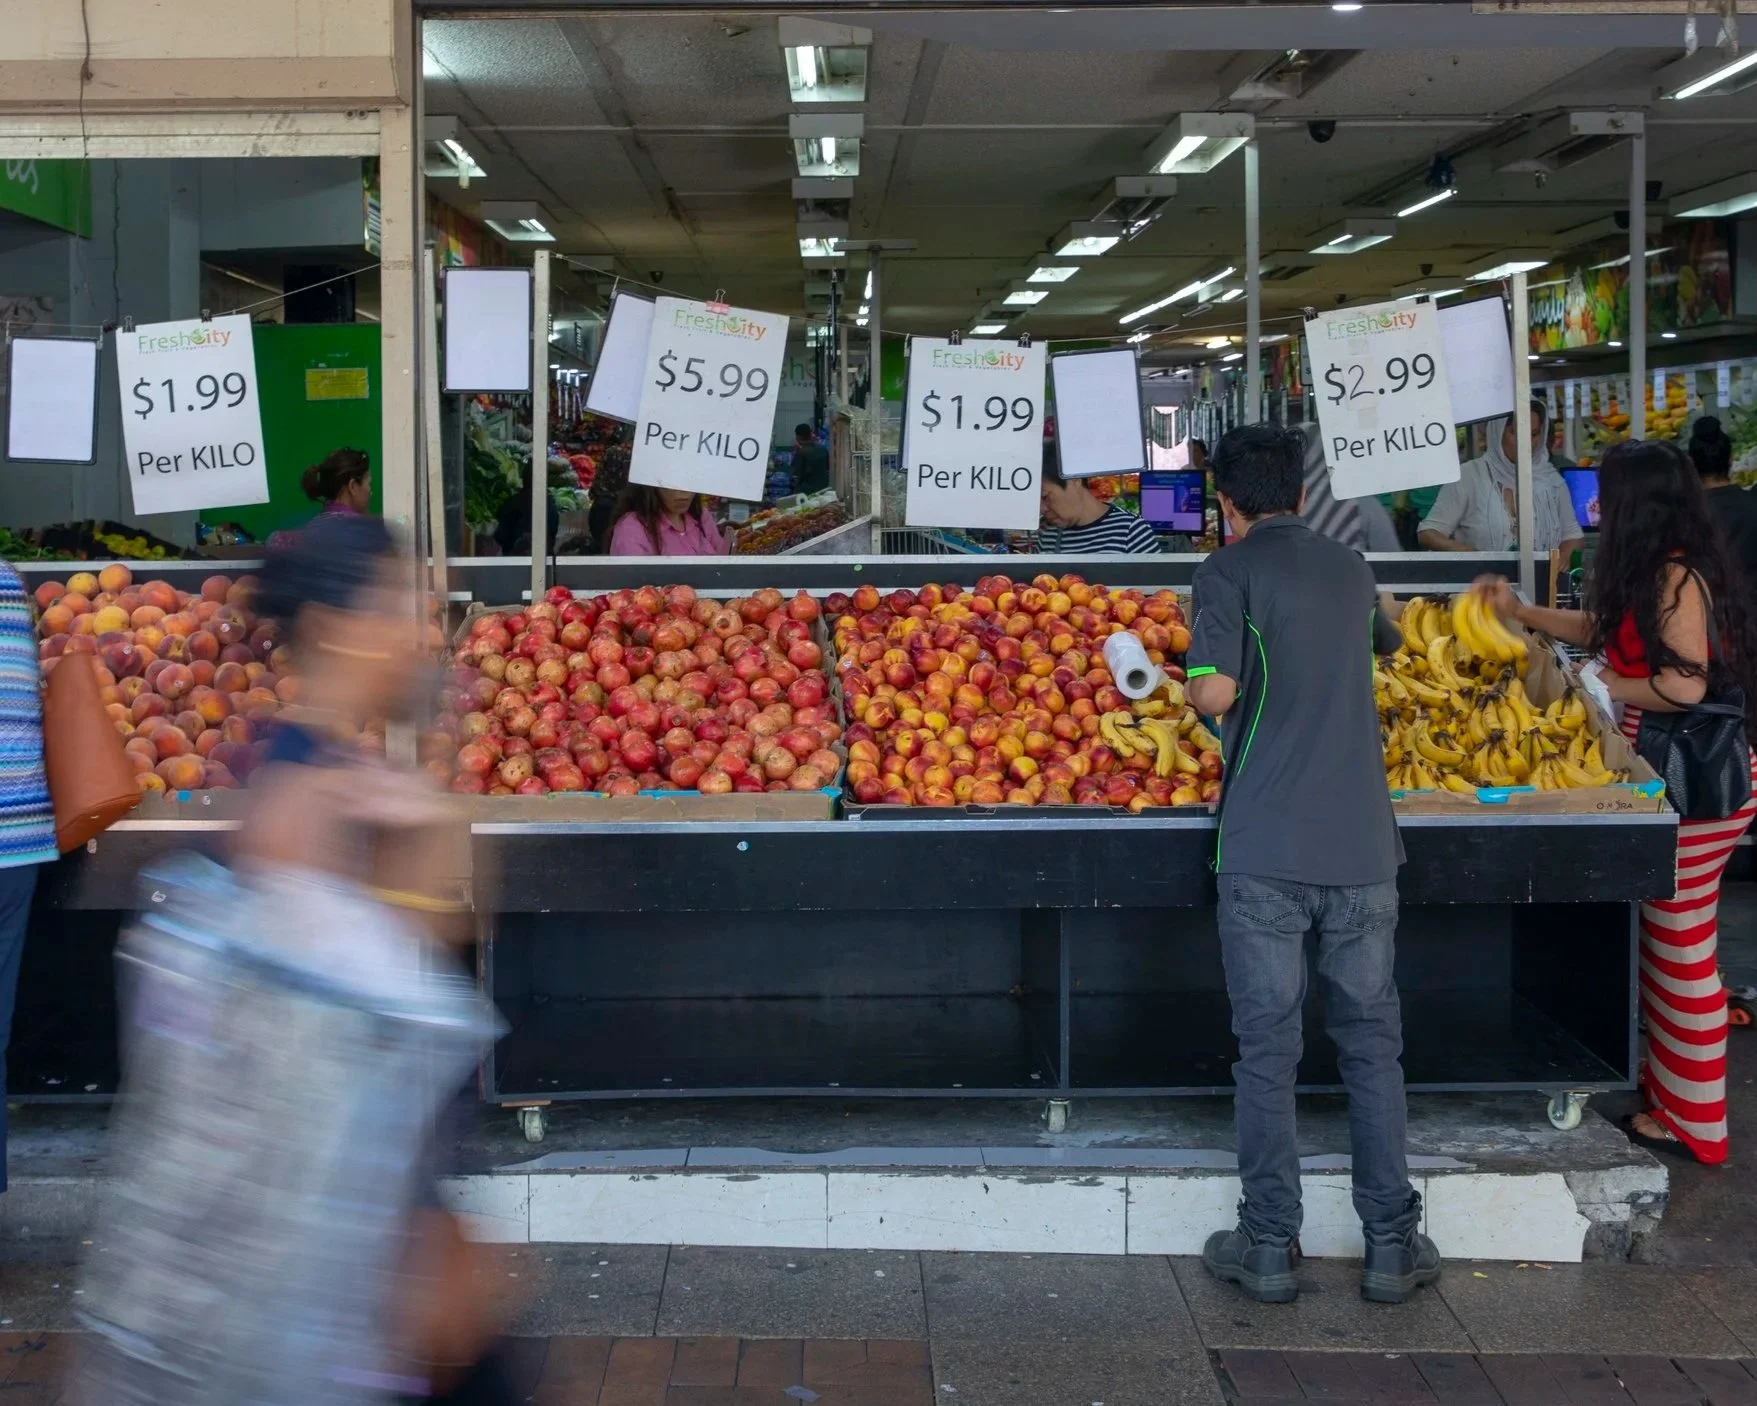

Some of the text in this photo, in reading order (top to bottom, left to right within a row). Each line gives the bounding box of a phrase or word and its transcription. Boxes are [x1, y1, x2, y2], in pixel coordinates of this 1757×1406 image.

[133, 372, 247, 420] $1.99
[655, 350, 769, 402] $5.99
[1324, 353, 1436, 406] $2.99
[921, 389, 1034, 433] $1.99
[137, 441, 255, 476] Per KILO
[644, 422, 760, 462] Per KILO
[1332, 422, 1447, 461] Per KILO
[918, 463, 1033, 492] Per KILO
